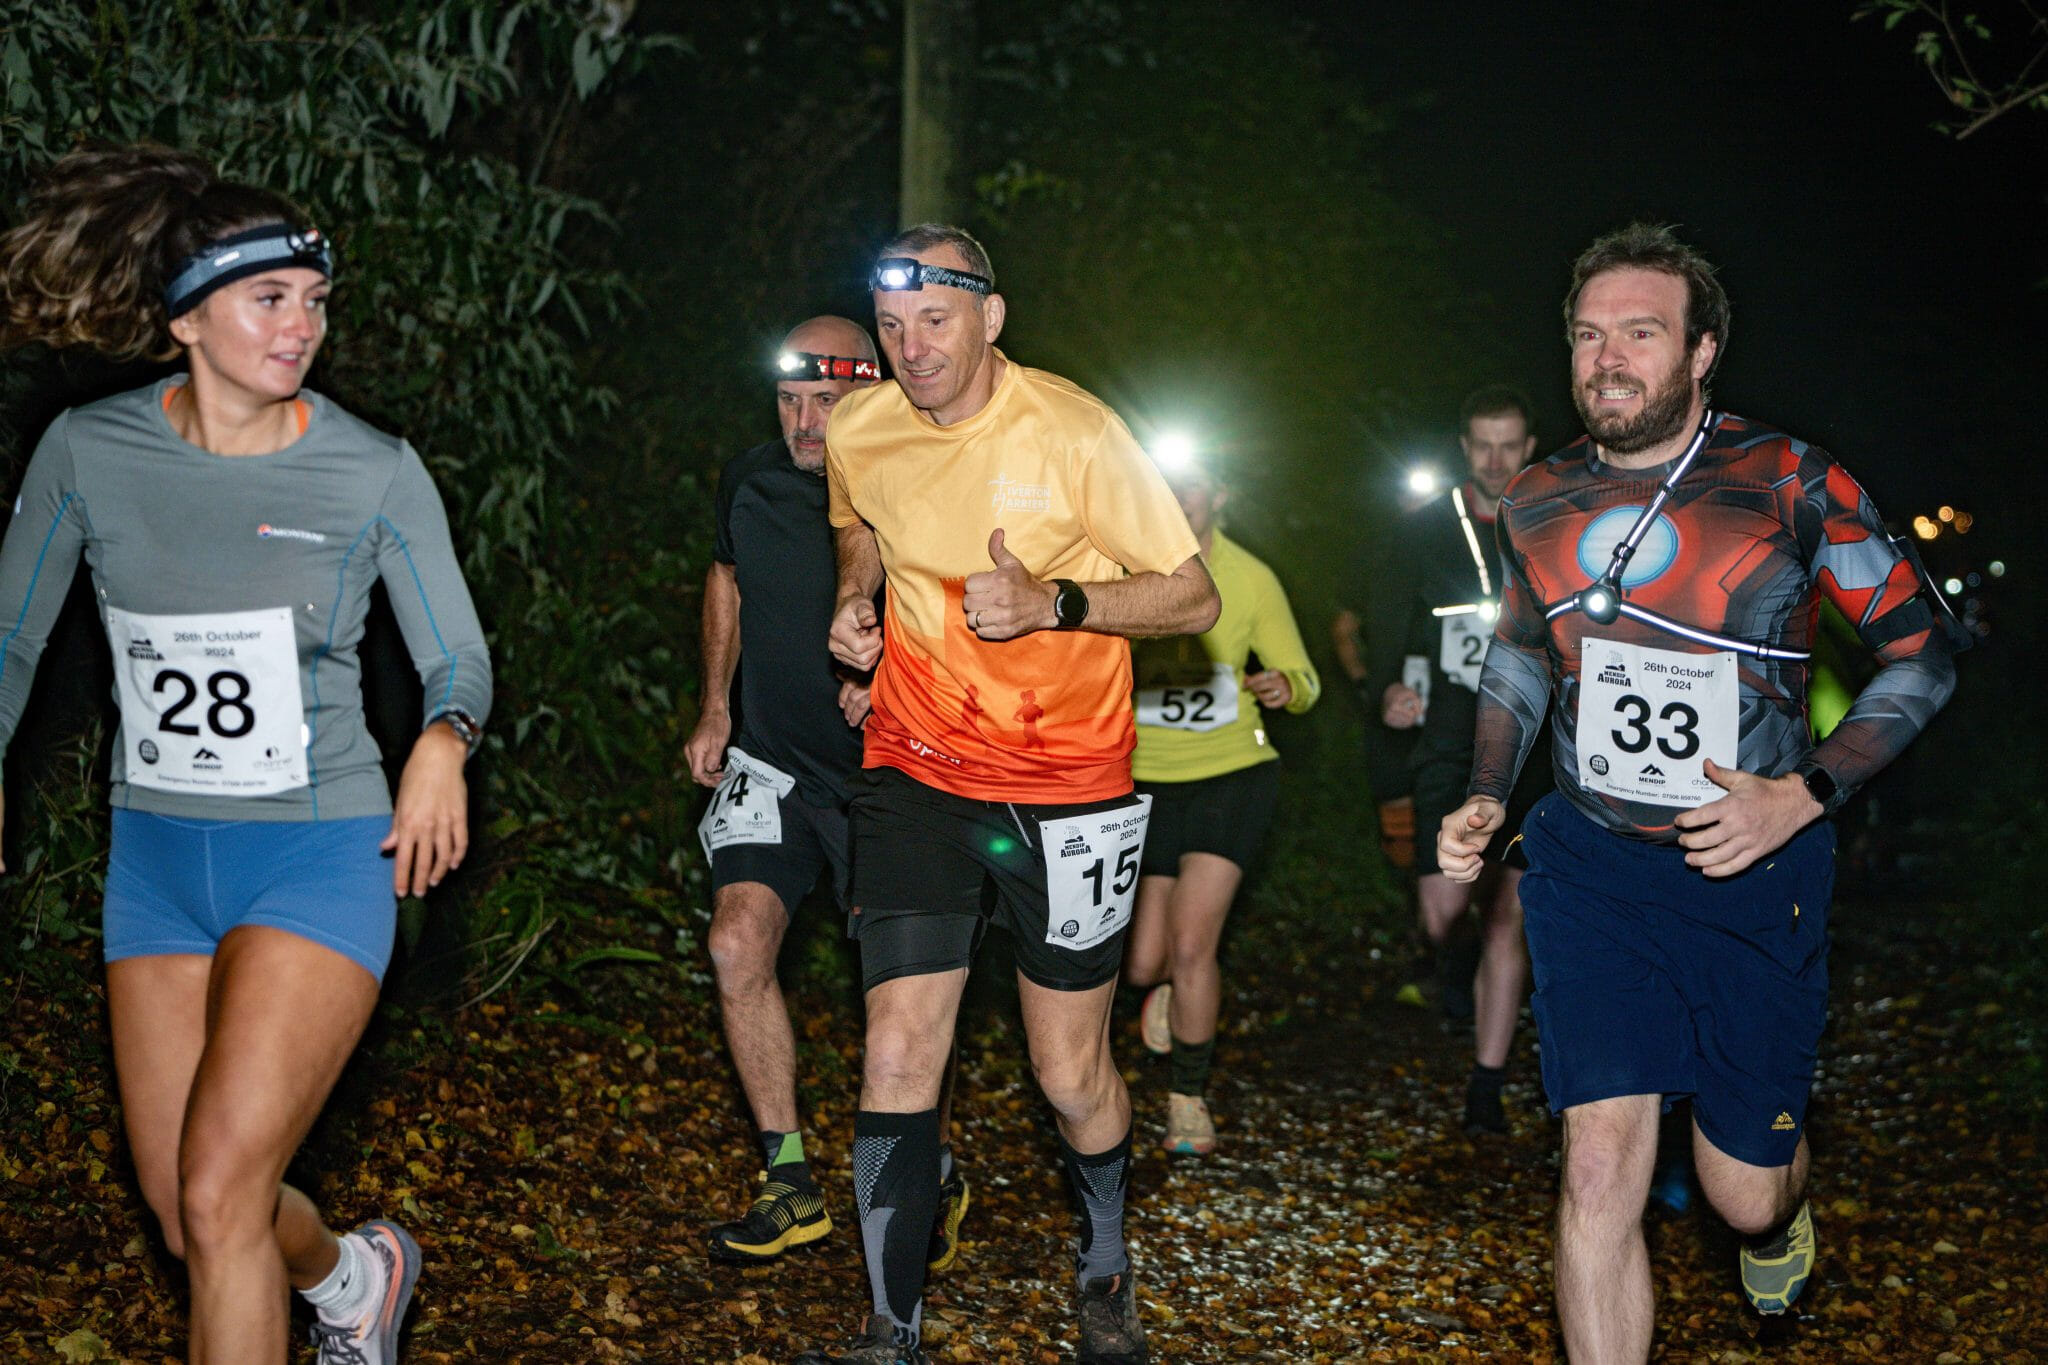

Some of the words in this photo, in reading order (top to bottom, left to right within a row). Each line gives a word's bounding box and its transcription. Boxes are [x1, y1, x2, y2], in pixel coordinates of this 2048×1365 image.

[174, 632, 202, 643] 26th
[206, 631, 261, 642] October
[204, 648, 235, 658] 2024
[1462, 635, 1485, 666] 2
[1643, 661, 1667, 674] 26th
[1670, 665, 1714, 679] October
[1597, 673, 1631, 687] AURORA
[1666, 679, 1692, 691] 2024
[153, 668, 256, 739] 28
[1161, 689, 1214, 722] 52
[1611, 694, 1700, 760] 33
[1638, 776, 1666, 785] MENDIP
[711, 770, 749, 817] 14
[1100, 823, 1121, 834] 26th
[1120, 828, 1138, 841] 2024
[1060, 845, 1092, 858] AURORA
[1064, 842, 1086, 850] MENDIP
[1082, 843, 1140, 907] 15
